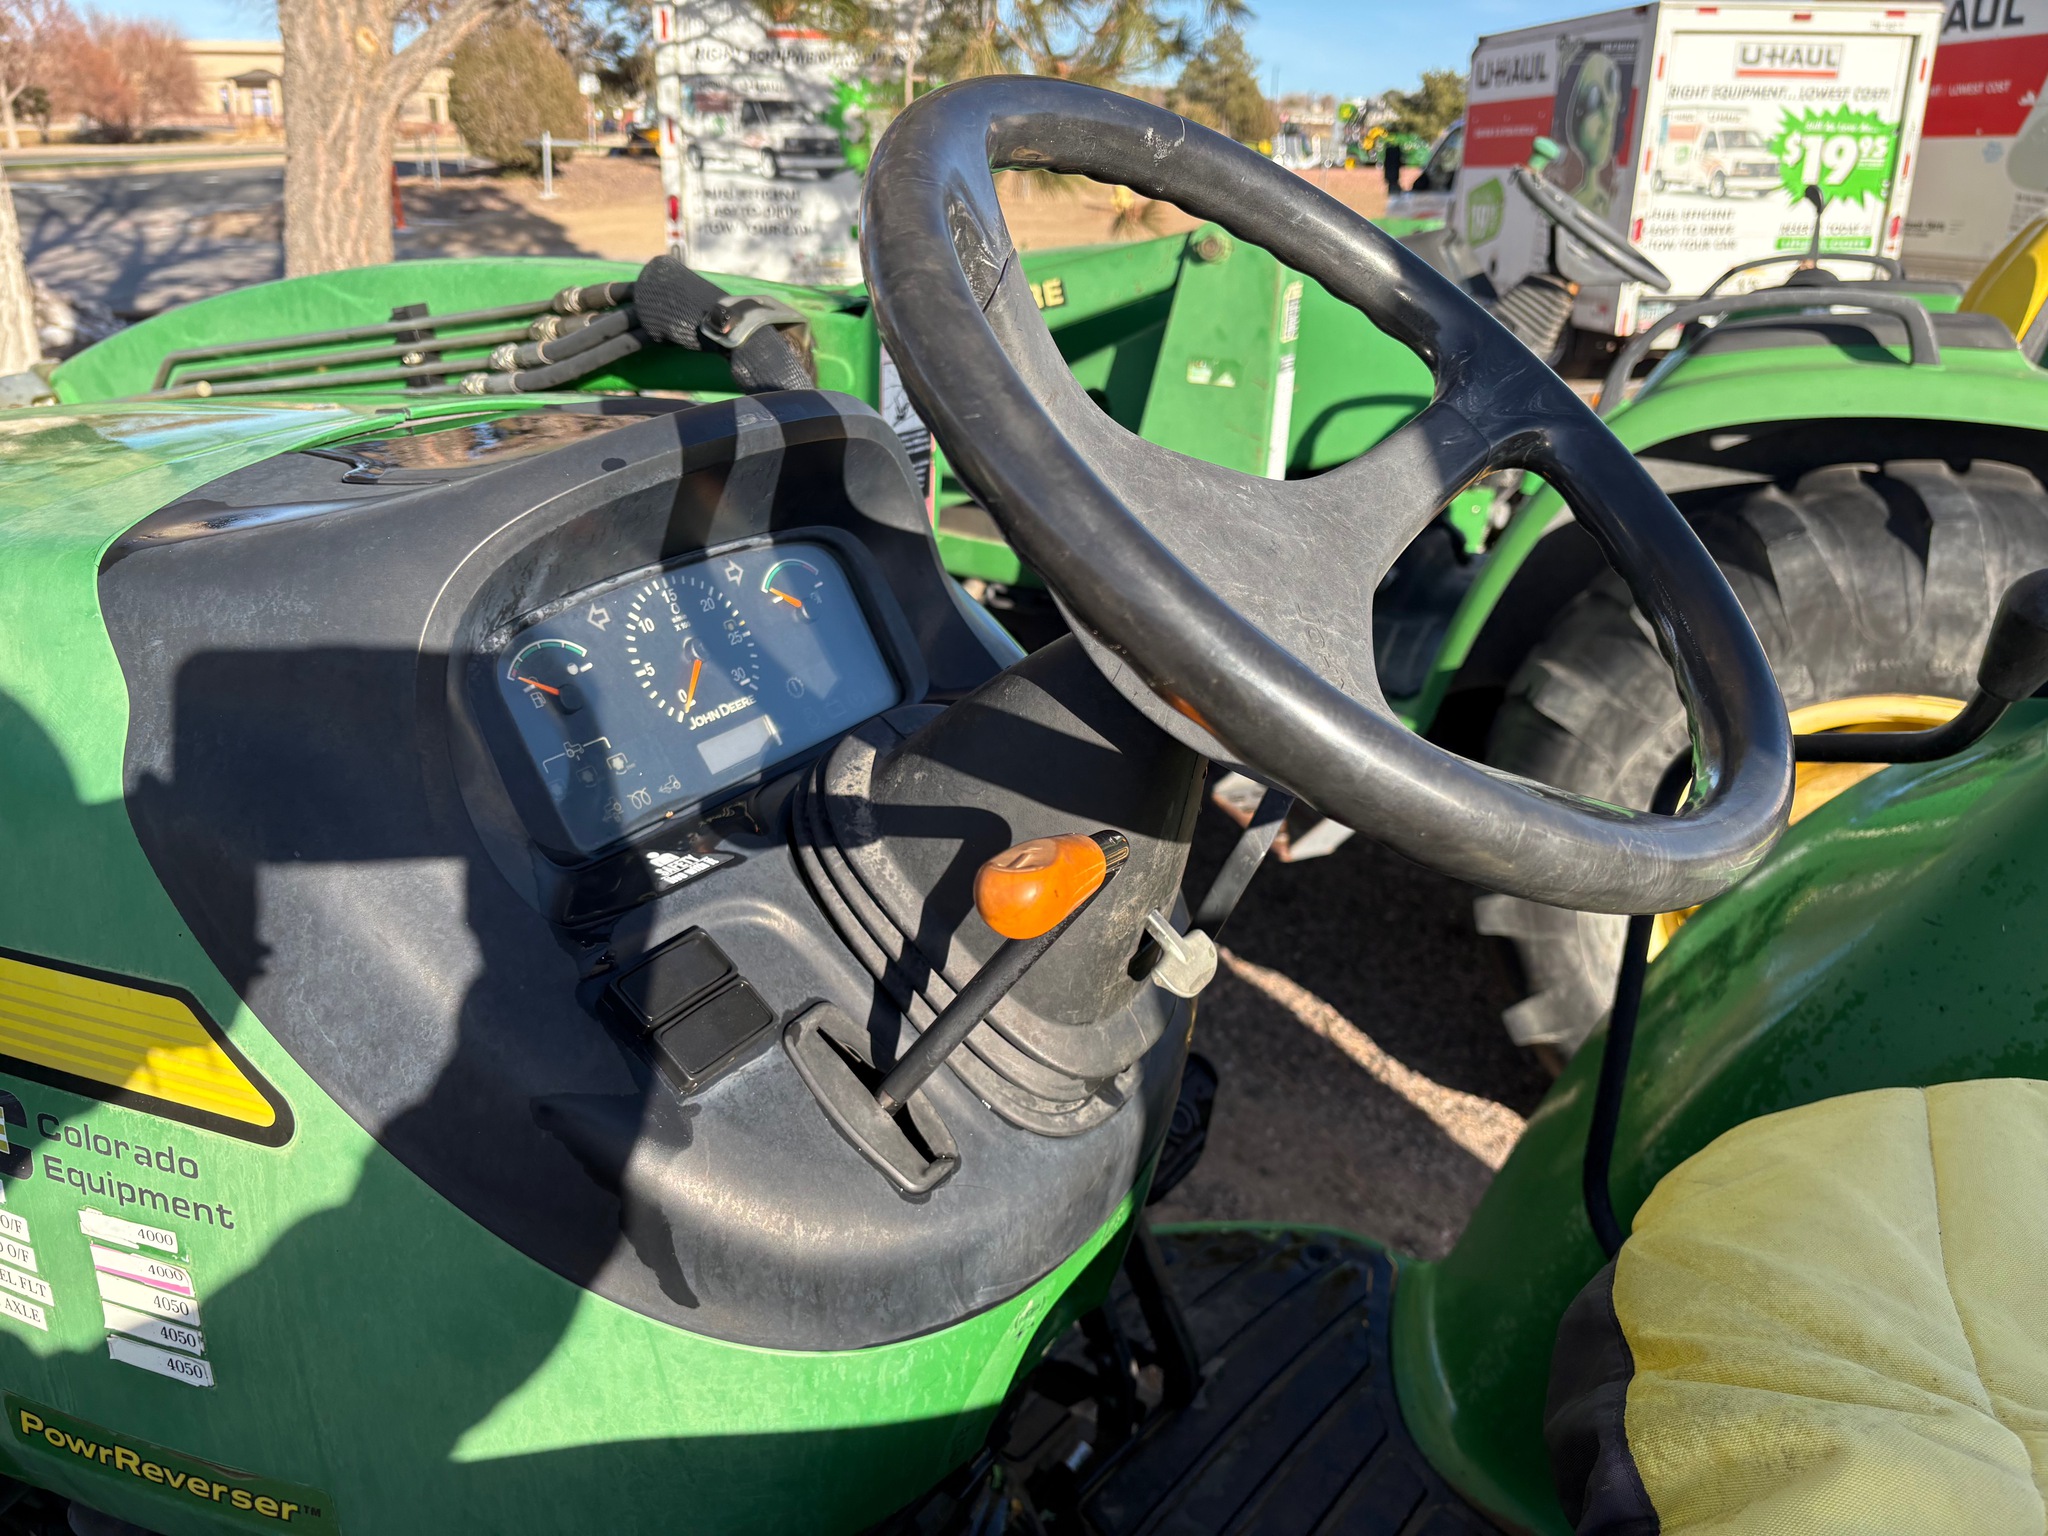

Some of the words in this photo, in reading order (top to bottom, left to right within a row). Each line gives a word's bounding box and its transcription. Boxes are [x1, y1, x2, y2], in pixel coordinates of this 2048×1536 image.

[1945, 0, 2024, 31] AUL
[1741, 45, 1838, 67] U-HAUL
[1475, 53, 1549, 88] U-HAUL
[661, 588, 677, 604] 15
[700, 597, 715, 612] 20
[638, 617, 655, 633] 10
[728, 633, 743, 646] 25
[643, 662, 655, 677] 5
[731, 667, 746, 682] 30
[677, 689, 687, 703] 0
[689, 708, 721, 731] JOHN
[718, 695, 757, 718] DEERE
[655, 853, 701, 876] SAFETY
[37, 1112, 199, 1181] Colorado
[43, 1153, 235, 1230] Equipment
[137, 1227, 174, 1248] 4000
[7, 1243, 29, 1264] O/F
[147, 1263, 184, 1283] 4000
[18, 1274, 47, 1298] FLT
[5, 1296, 41, 1323] AXLE
[153, 1294, 190, 1317] 4050
[159, 1325, 197, 1349] 4050
[166, 1356, 204, 1380] 4050
[19, 1408, 300, 1523] PowrReverser
